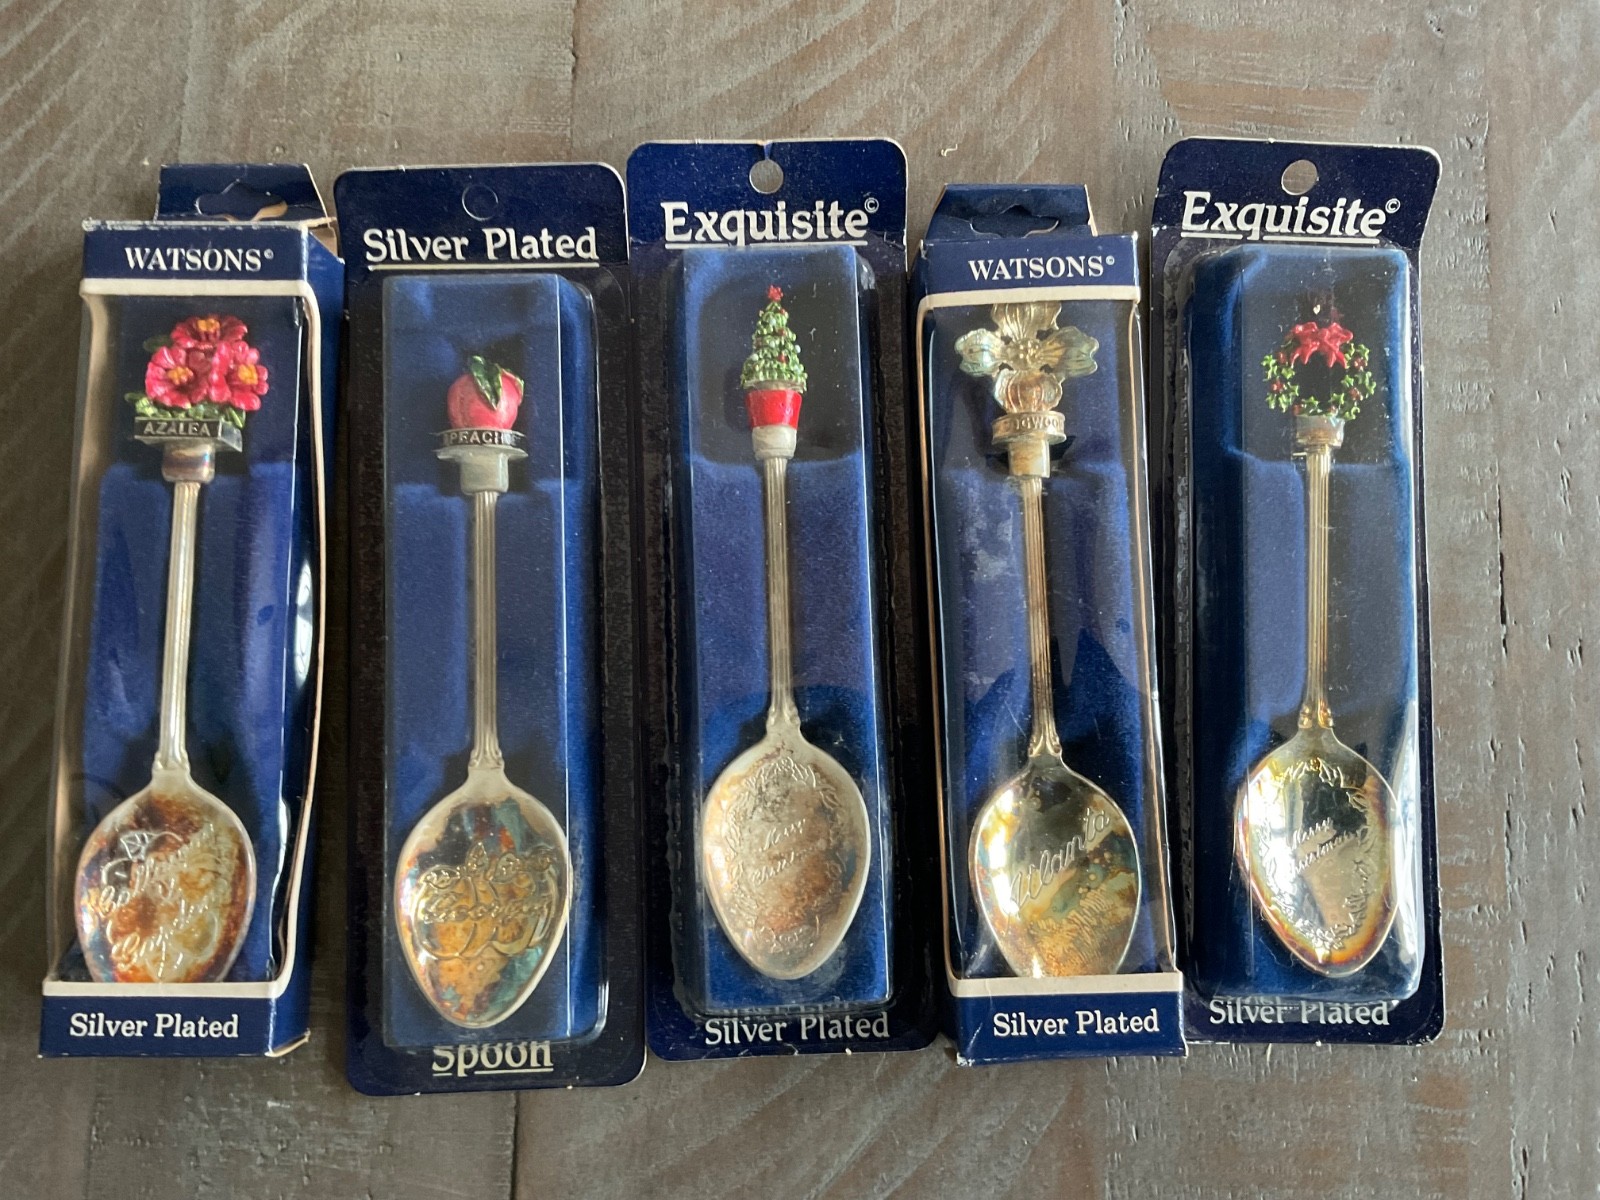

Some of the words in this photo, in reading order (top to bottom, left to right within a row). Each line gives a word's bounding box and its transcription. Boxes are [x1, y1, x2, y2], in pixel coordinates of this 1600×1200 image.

[363, 228, 469, 262] Silver
[482, 226, 599, 260] Plated
[143, 421, 211, 437] AZALEA
[69, 1012, 148, 1037] Silver
[153, 1012, 239, 1038] Plated
[993, 1011, 1069, 1037] Silver
[1075, 1008, 1160, 1035] Plated
[1209, 999, 1288, 1024] Silver
[1301, 1000, 1389, 1025] Plated
[704, 1017, 787, 1045] Silver
[800, 1011, 890, 1040] Plated
